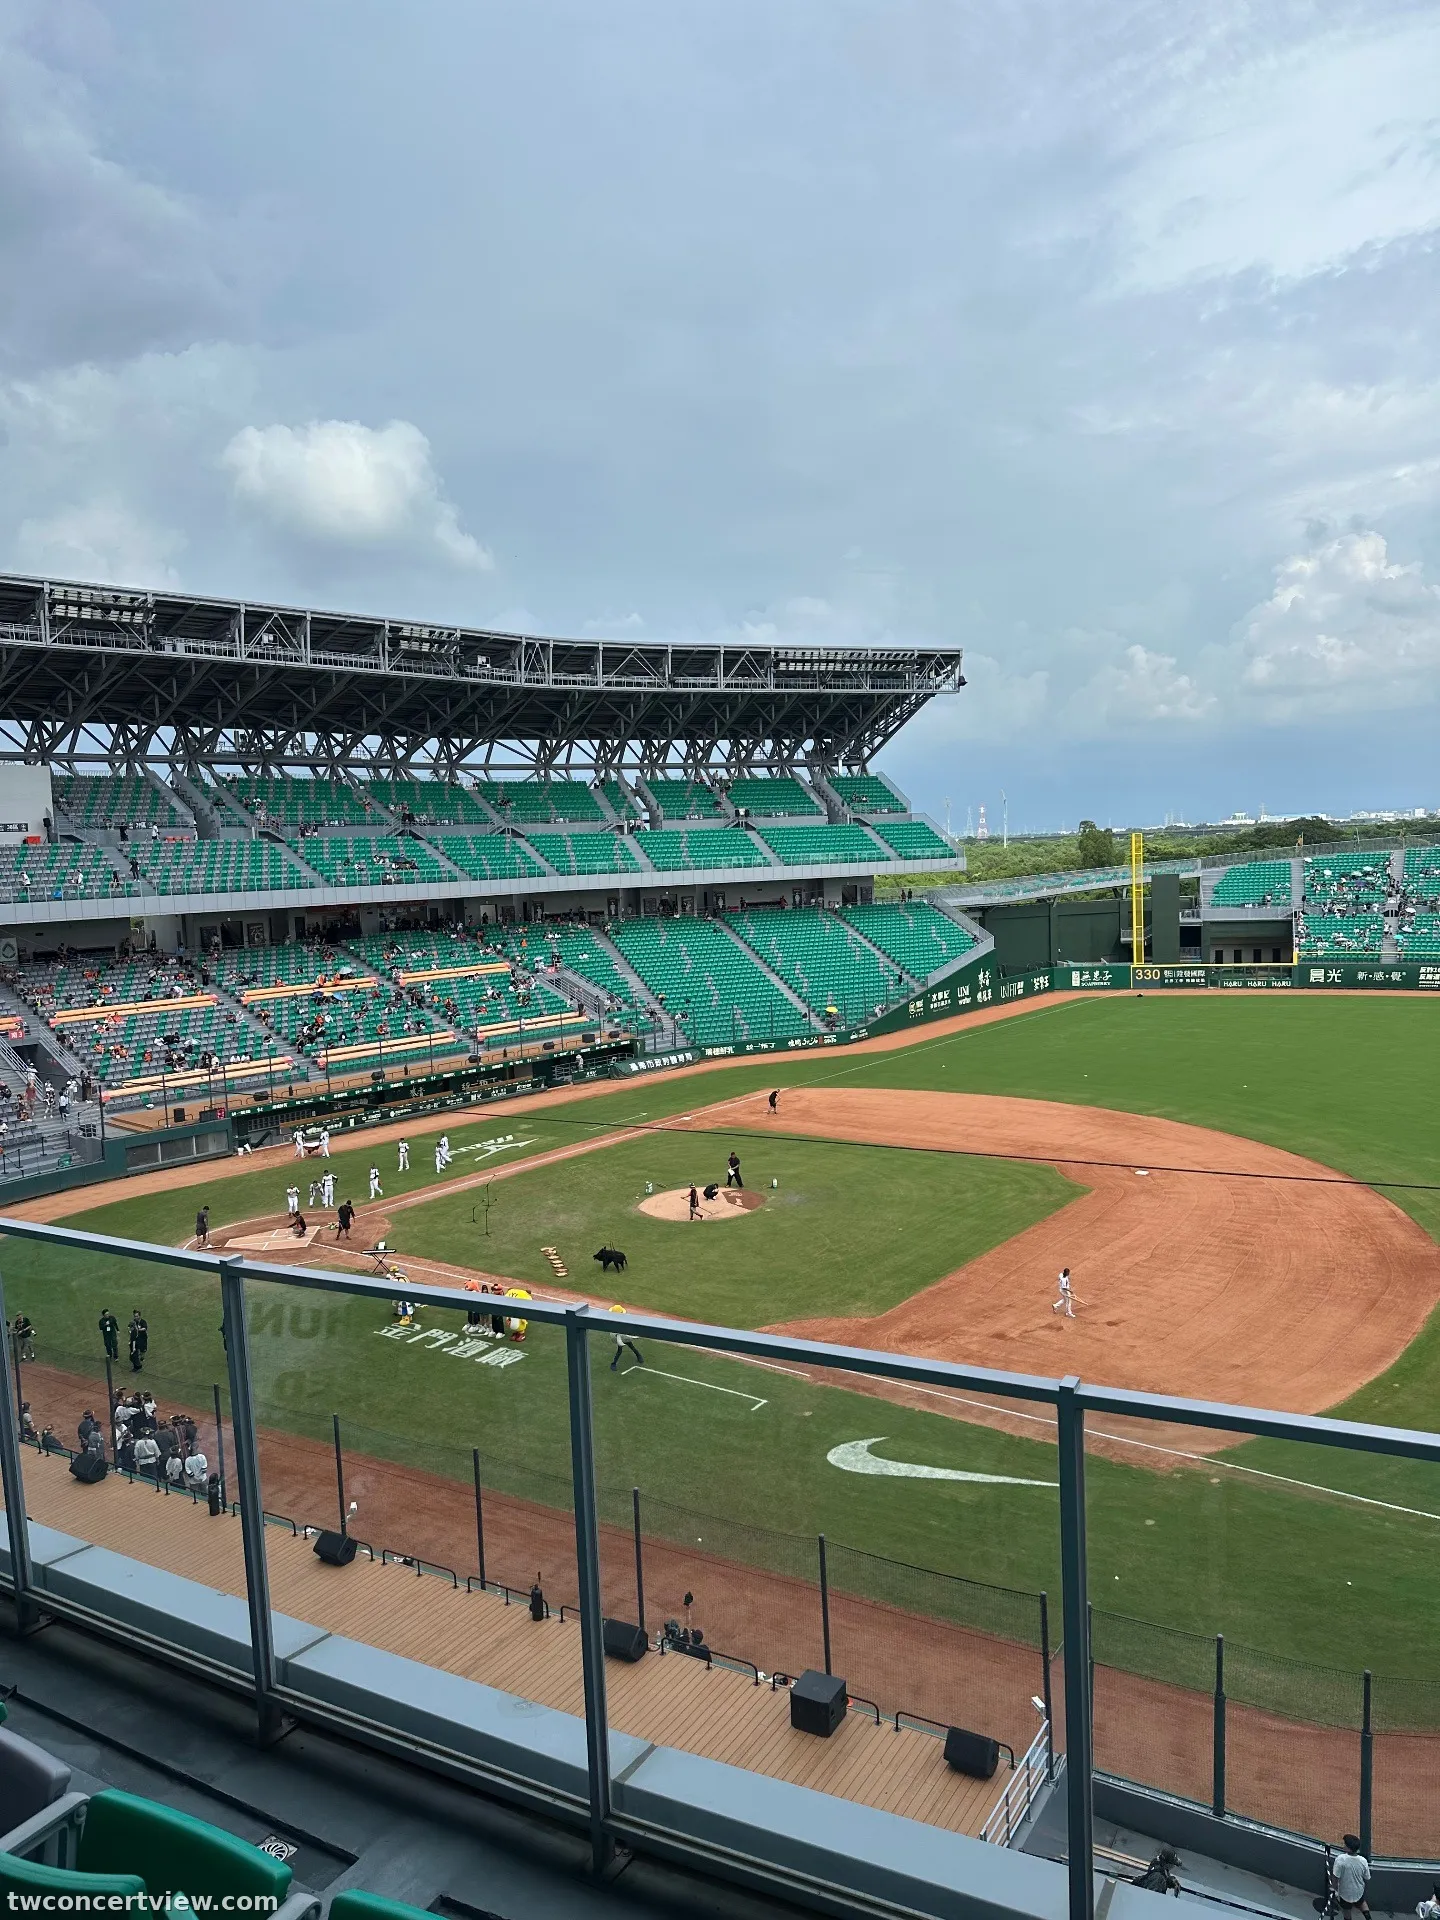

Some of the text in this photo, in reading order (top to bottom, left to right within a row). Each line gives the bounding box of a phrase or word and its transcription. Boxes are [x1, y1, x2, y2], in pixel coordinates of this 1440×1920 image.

[1135, 969, 1161, 980] 330
[1309, 968, 1342, 983] 晨光
[1223, 980, 1242, 988] HARU
[1247, 980, 1267, 988] HARU
[1272, 980, 1291, 988] HARU
